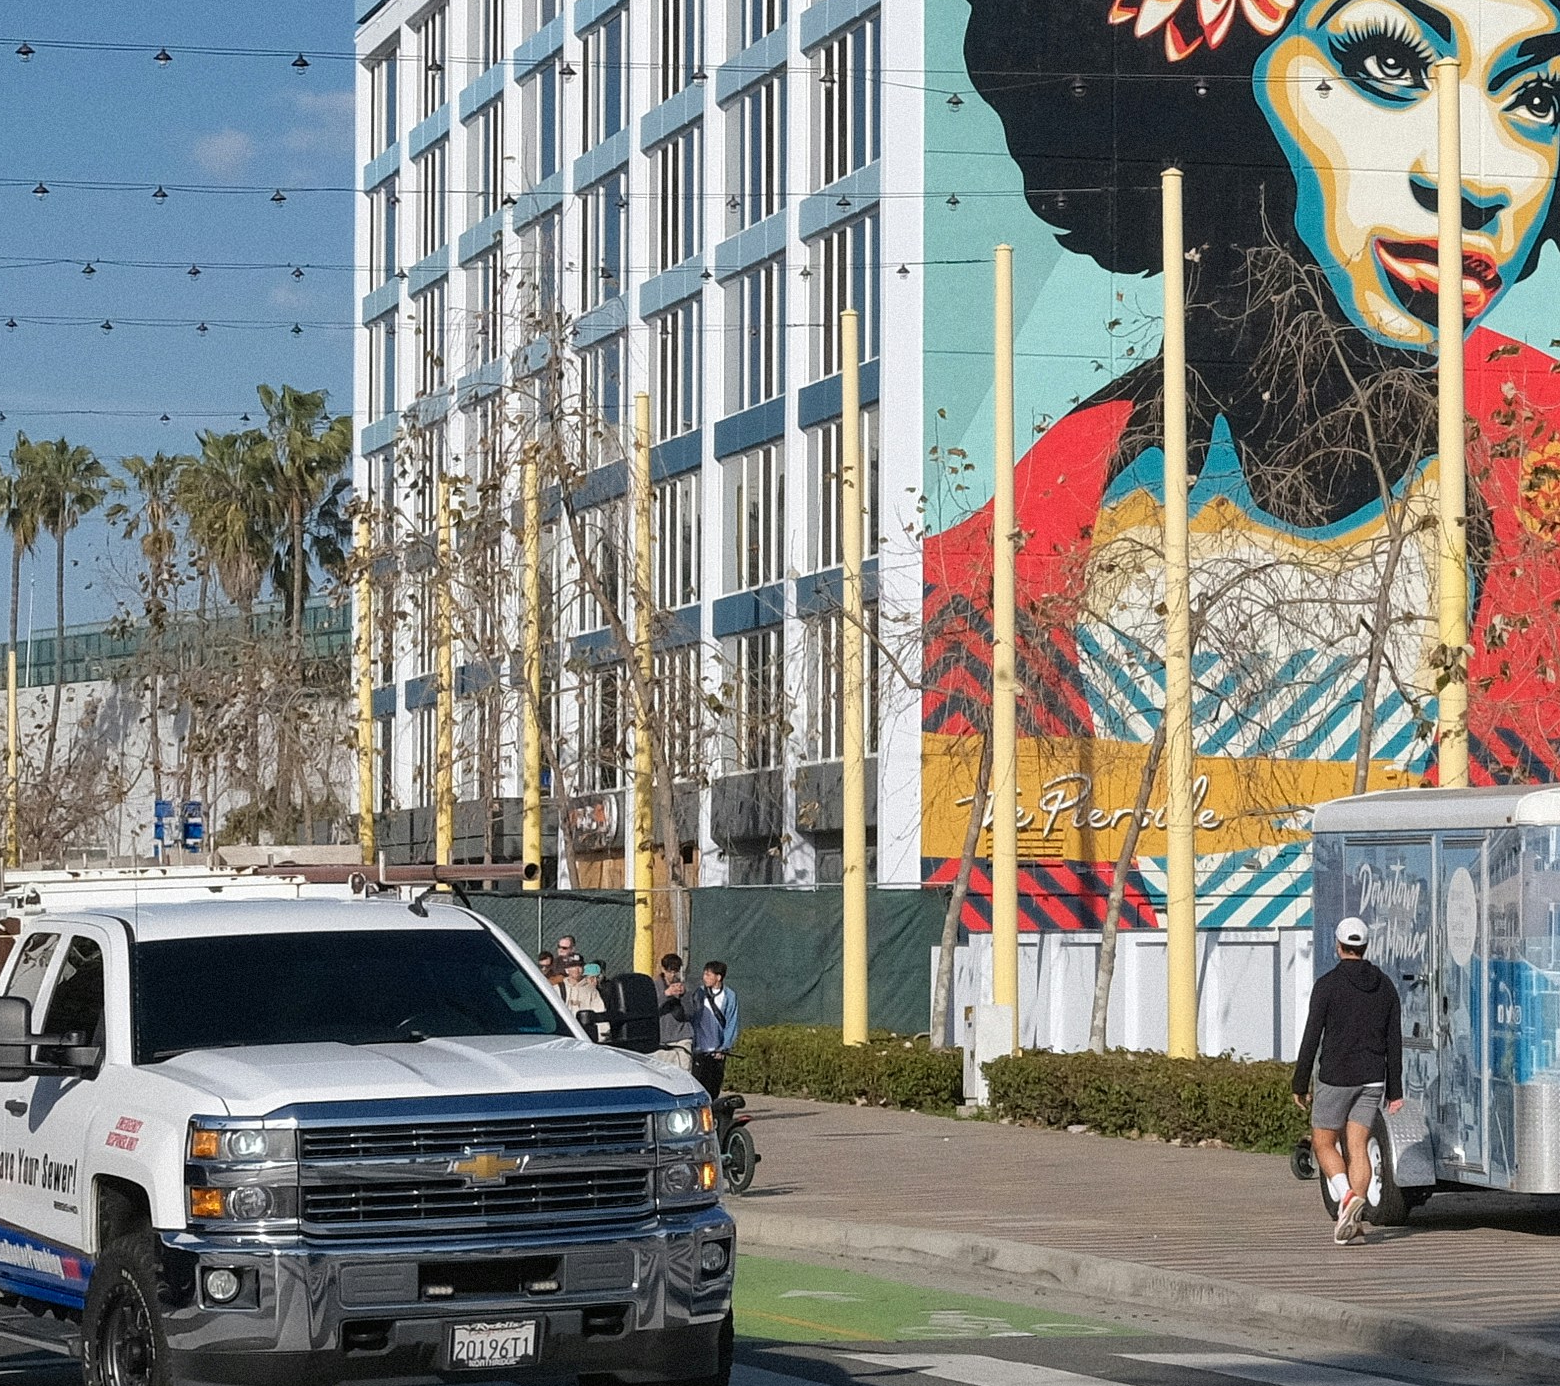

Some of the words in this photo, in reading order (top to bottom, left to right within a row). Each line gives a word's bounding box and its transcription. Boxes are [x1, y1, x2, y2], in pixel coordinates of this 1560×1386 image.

[1358, 859, 1421, 925] Downtown
[18, 1147, 40, 1186] Your
[41, 1153, 78, 1195] Sewer!
[455, 1336, 529, 1361] 20196T1
